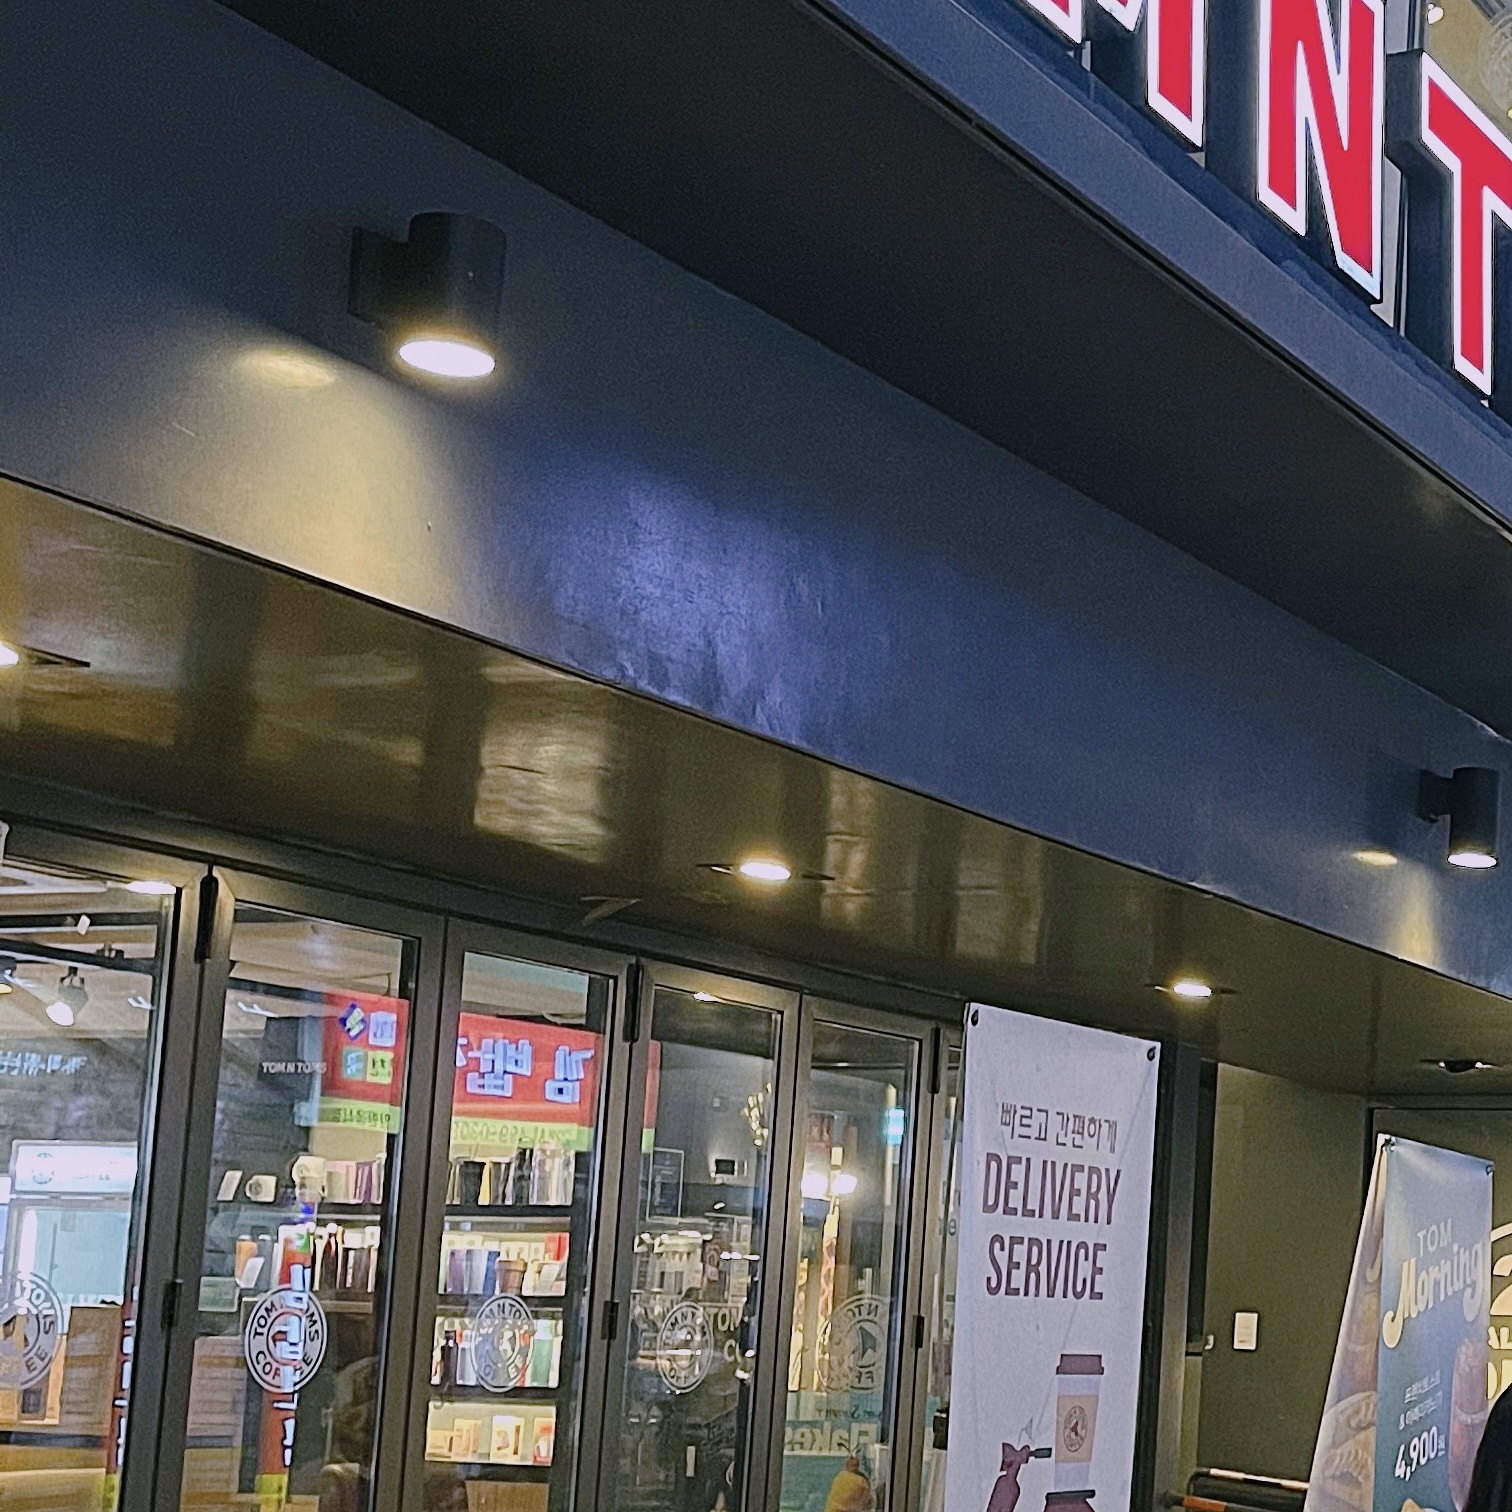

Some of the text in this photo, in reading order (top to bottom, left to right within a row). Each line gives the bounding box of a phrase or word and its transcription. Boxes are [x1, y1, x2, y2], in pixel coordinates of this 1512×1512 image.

[1000, 1102, 1118, 1154] 빠르고 간편하게
[982, 1152, 1122, 1226] DELIVERY
[985, 1233, 1108, 1301] SERVICE
[1417, 1218, 1452, 1258] TOM
[1382, 1241, 1490, 1349] Morning
